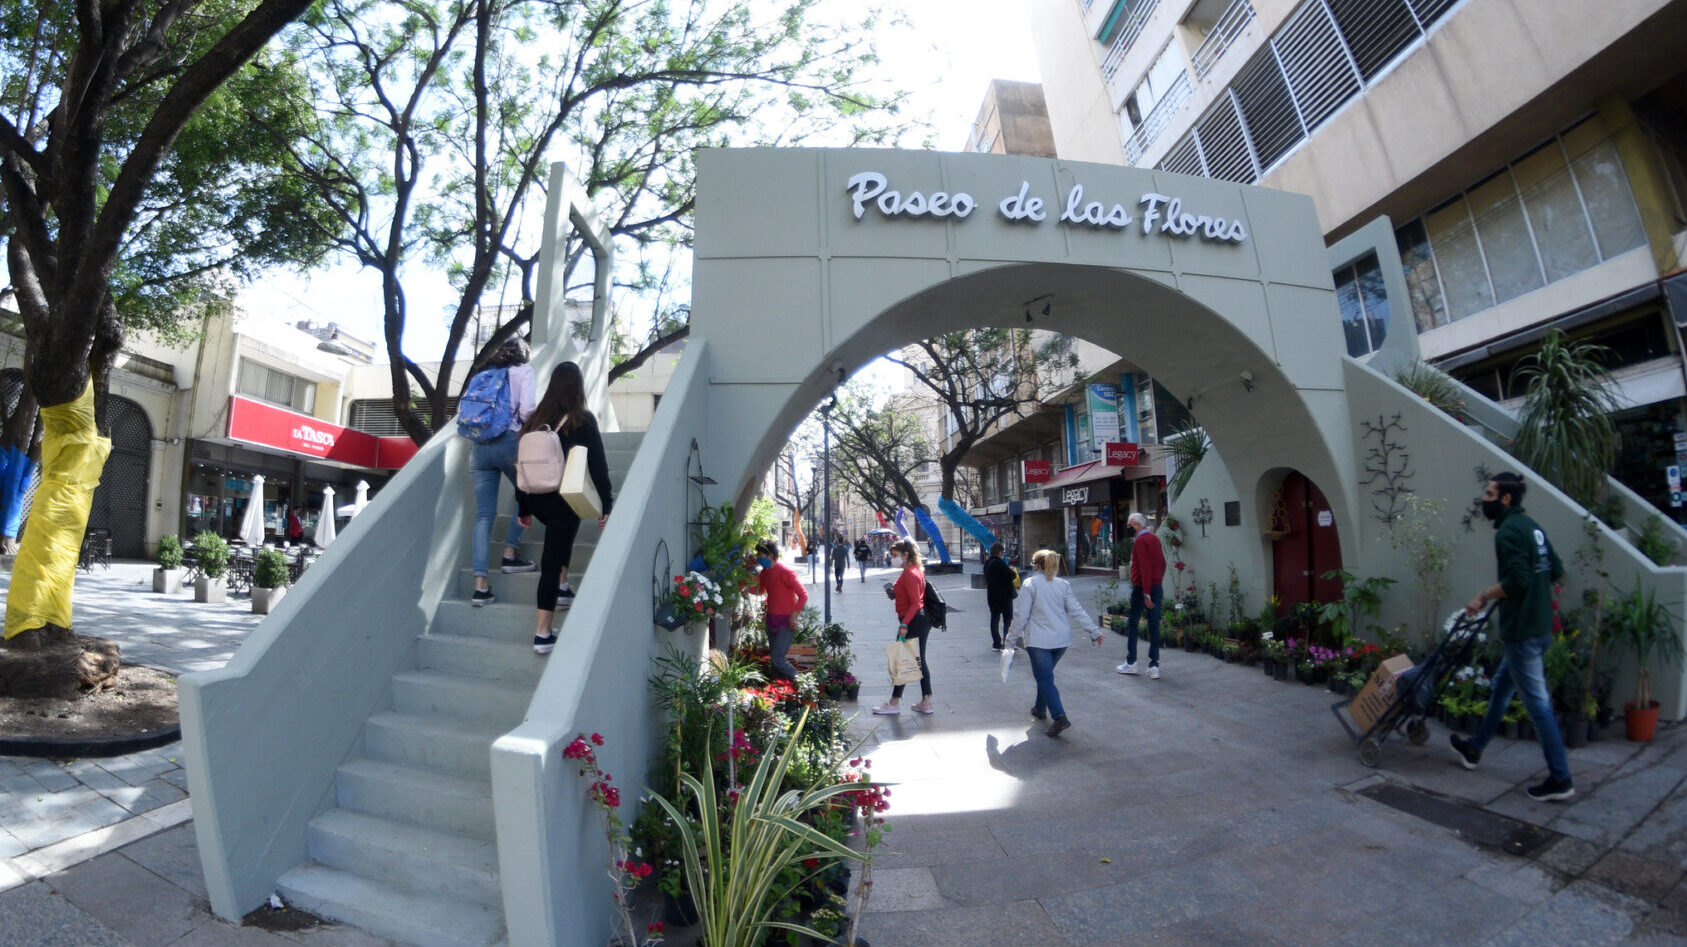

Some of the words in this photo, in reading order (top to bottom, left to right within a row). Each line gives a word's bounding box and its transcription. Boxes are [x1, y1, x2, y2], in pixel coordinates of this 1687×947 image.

[847, 171, 978, 220] Paseo
[1000, 181, 1047, 223] de
[1061, 184, 1133, 228] las
[1139, 193, 1249, 244] Flores
[302, 425, 335, 447] TASCA
[1108, 448, 1137, 460] Legacy
[1025, 466, 1049, 476] Legacy
[1062, 487, 1088, 505] Legacy
